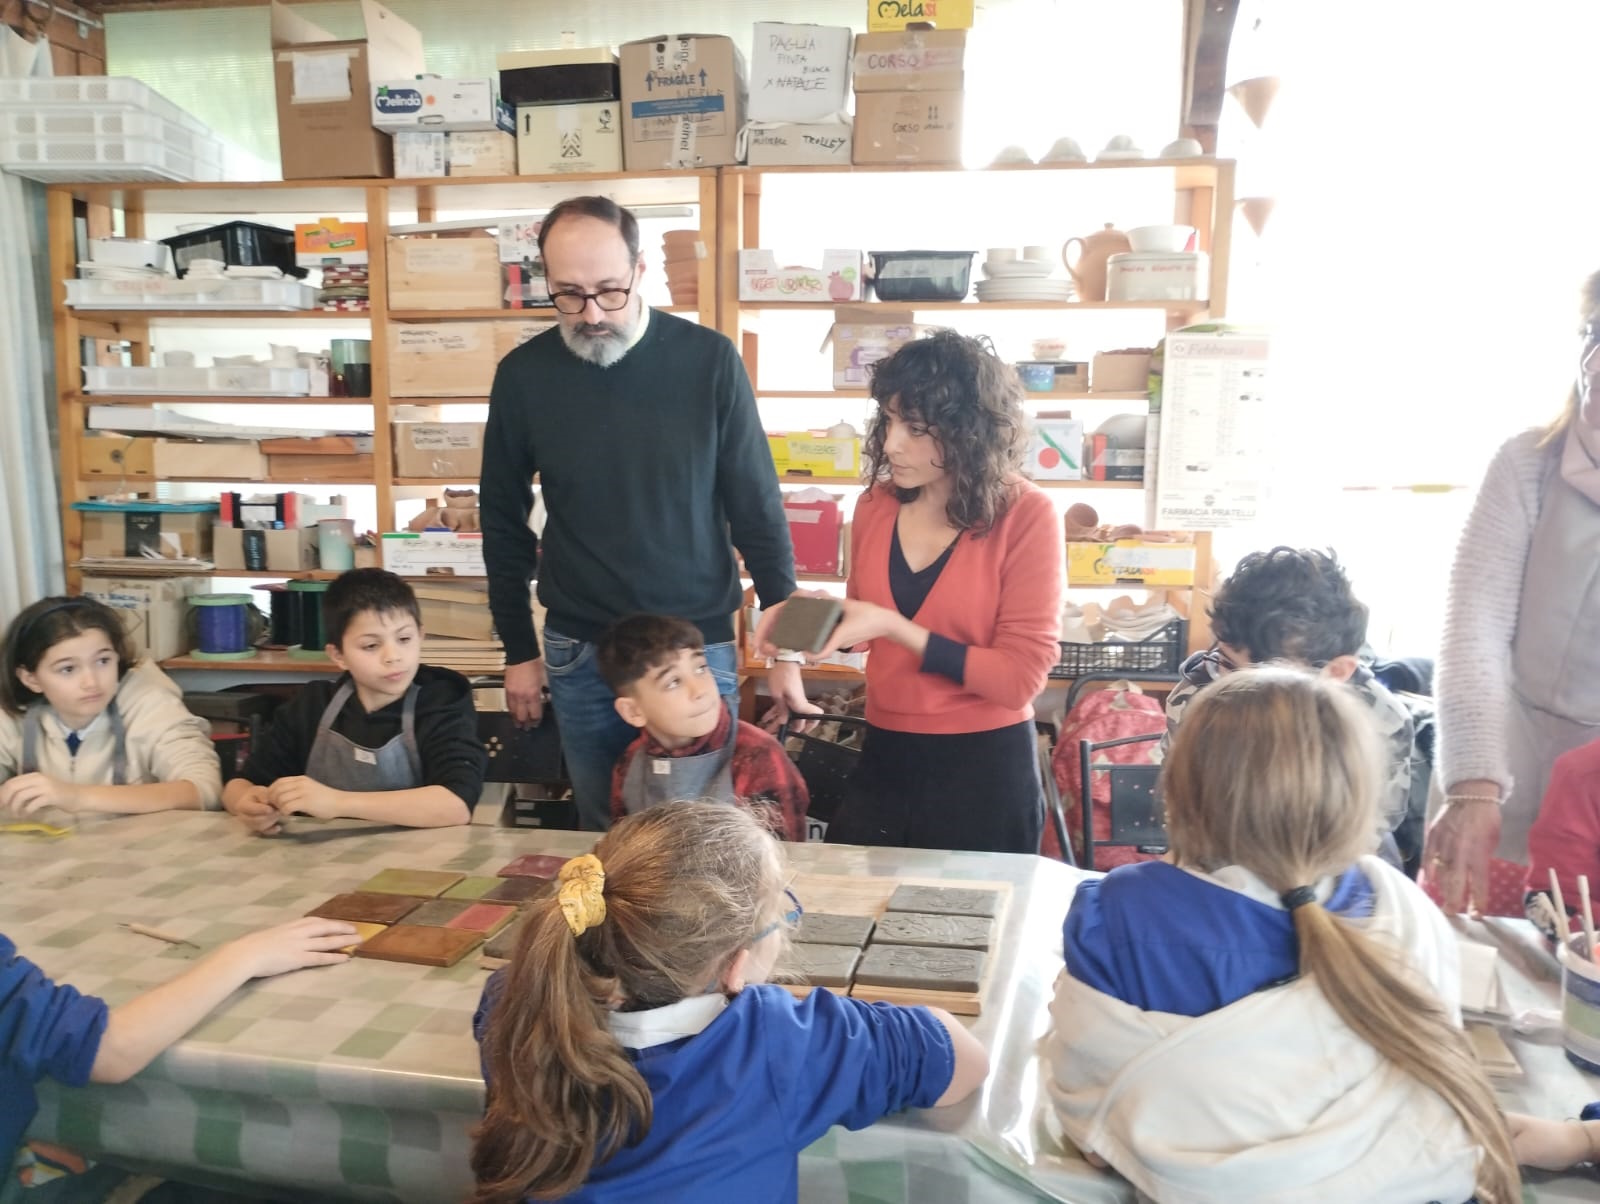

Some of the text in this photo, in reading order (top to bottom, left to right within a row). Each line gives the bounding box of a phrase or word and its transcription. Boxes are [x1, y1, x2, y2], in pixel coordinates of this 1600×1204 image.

[867, 54, 919, 70] CORSO
[656, 74, 696, 87] FRAGILE
[377, 94, 421, 107] Melinda
[802, 135, 846, 154] TROLLEY
[1161, 507, 1209, 516] FARMACIA
